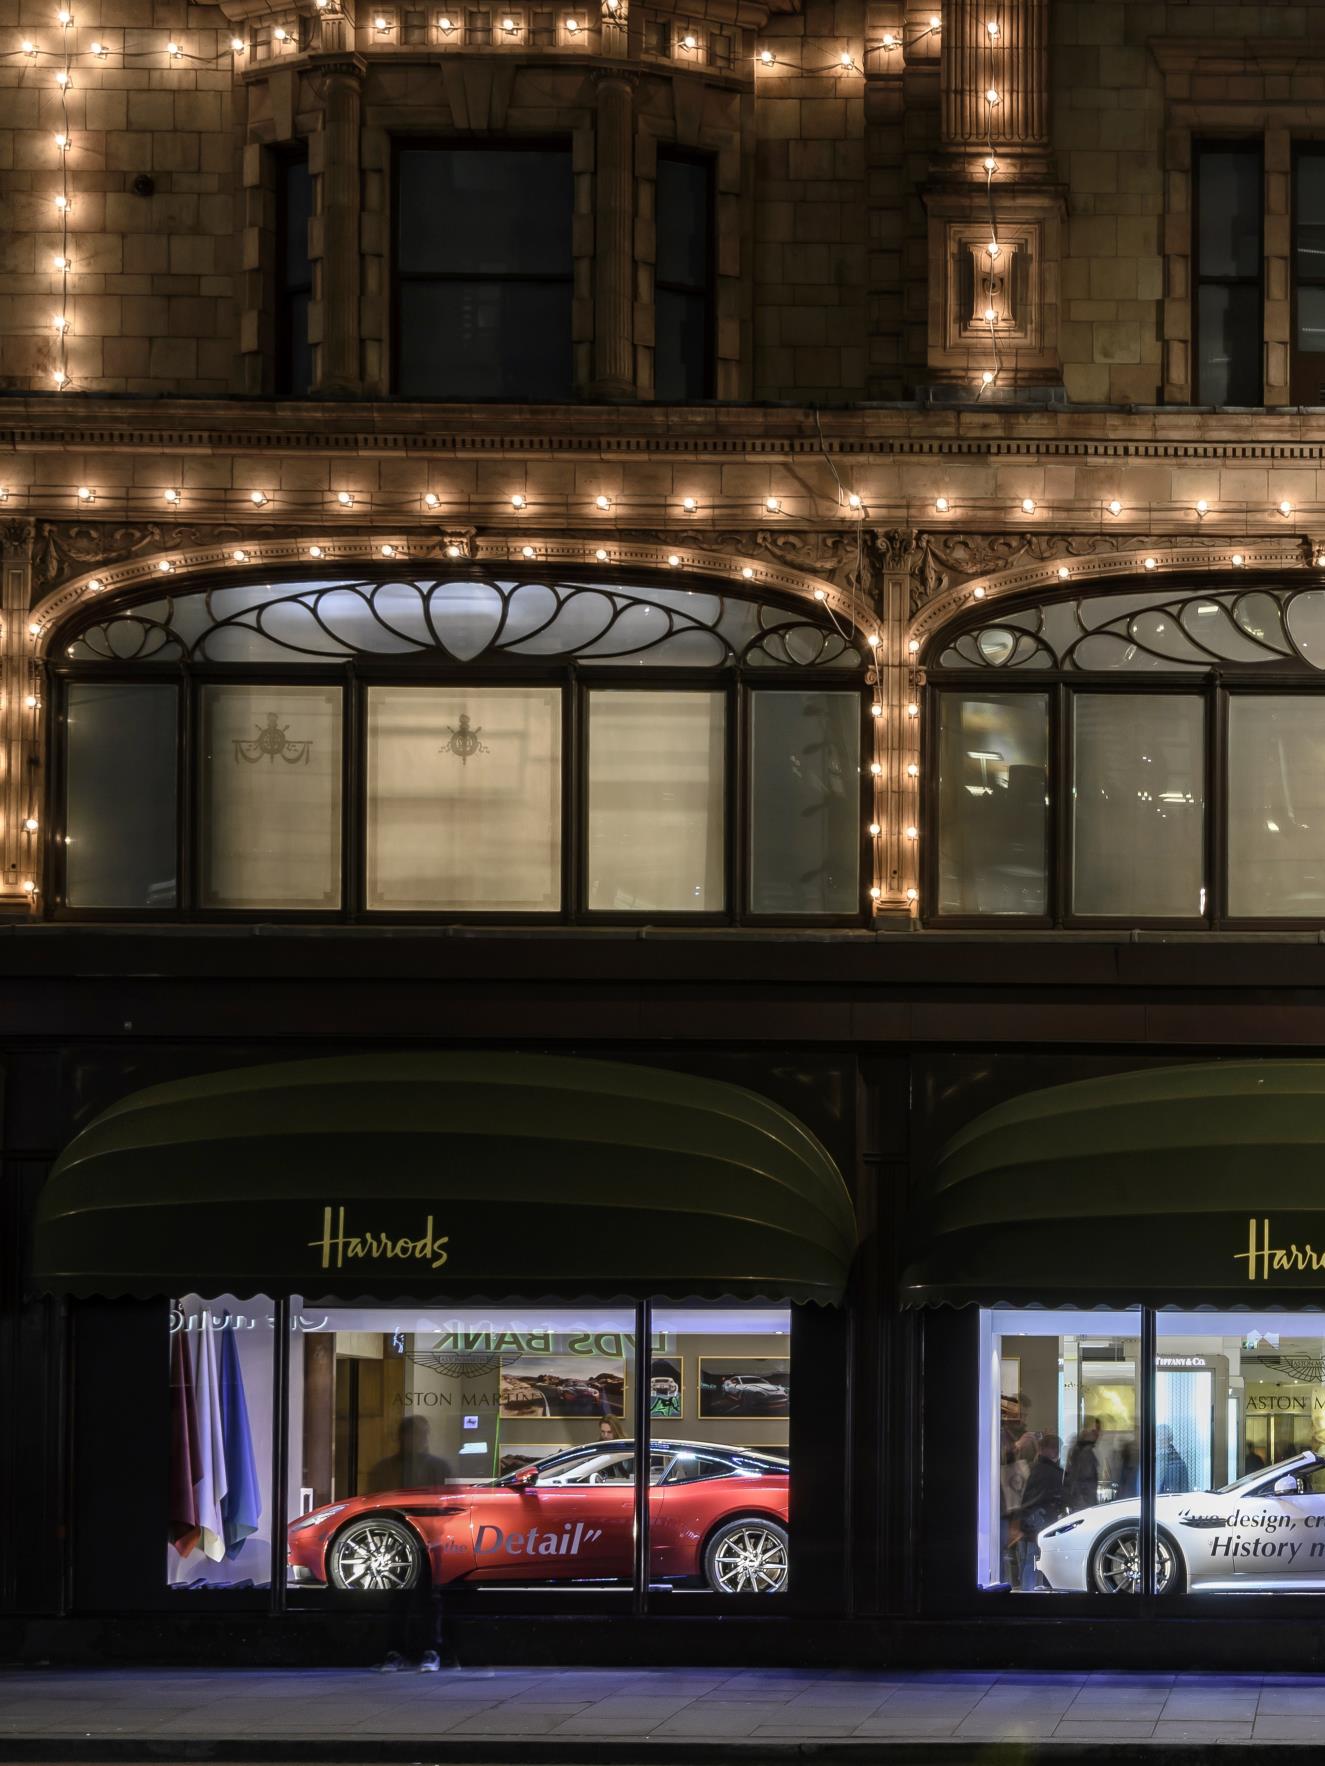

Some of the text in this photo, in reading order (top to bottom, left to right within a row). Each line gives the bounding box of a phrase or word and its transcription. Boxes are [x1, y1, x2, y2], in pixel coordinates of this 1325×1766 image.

[307, 1206, 449, 1268] Harrods
[392, 1392, 536, 1407] ASTON MARTIN
[1246, 1396, 1306, 1410] ASTON
[1225, 1510, 1296, 1532] design,
[1210, 1535, 1303, 1565] History
